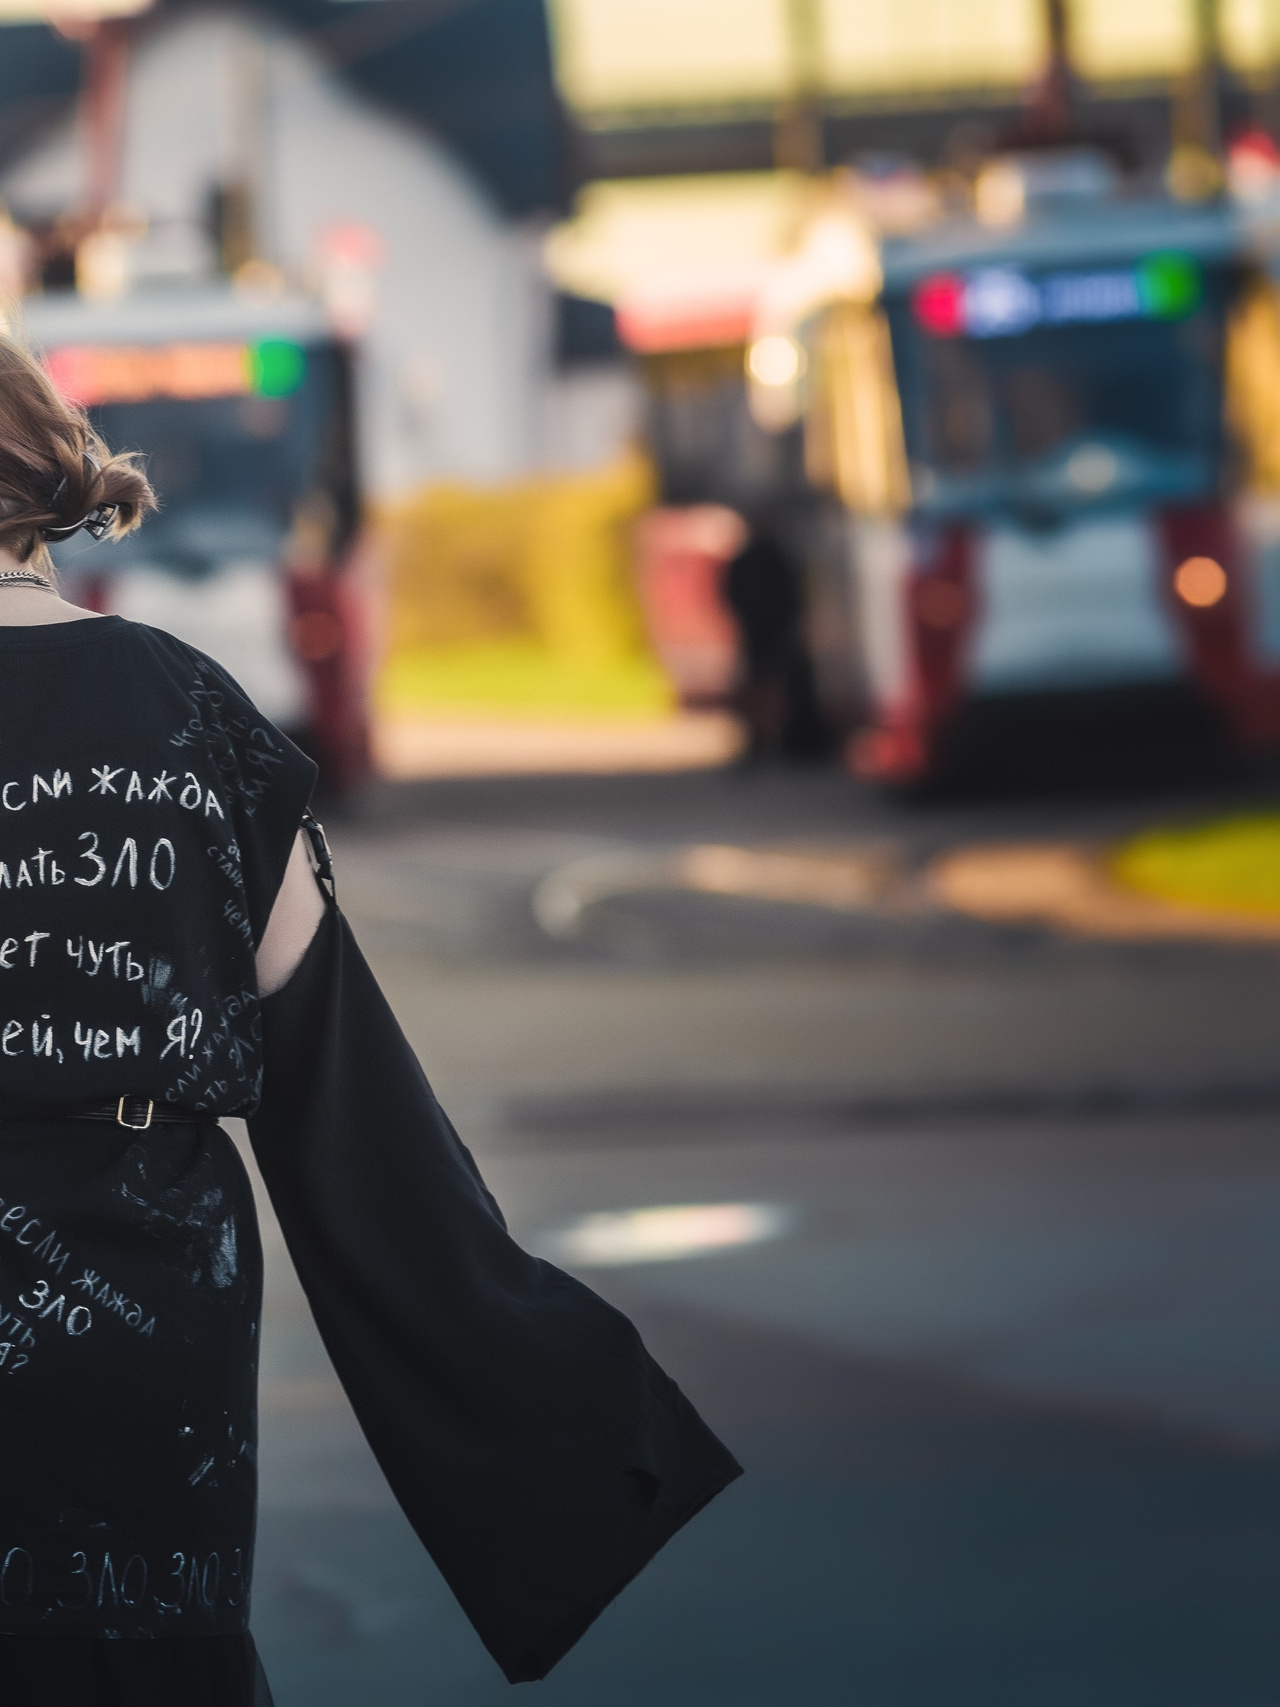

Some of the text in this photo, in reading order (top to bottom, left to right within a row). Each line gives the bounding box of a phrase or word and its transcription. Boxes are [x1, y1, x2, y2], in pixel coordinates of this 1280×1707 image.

[74, 831, 176, 891] ЗЛО
[74, 1021, 142, 1062] чем
[158, 1008, 204, 1062] Я?
[18, 1280, 93, 1336] ЗЛО
[58, 1551, 149, 1609] ЗЛО
